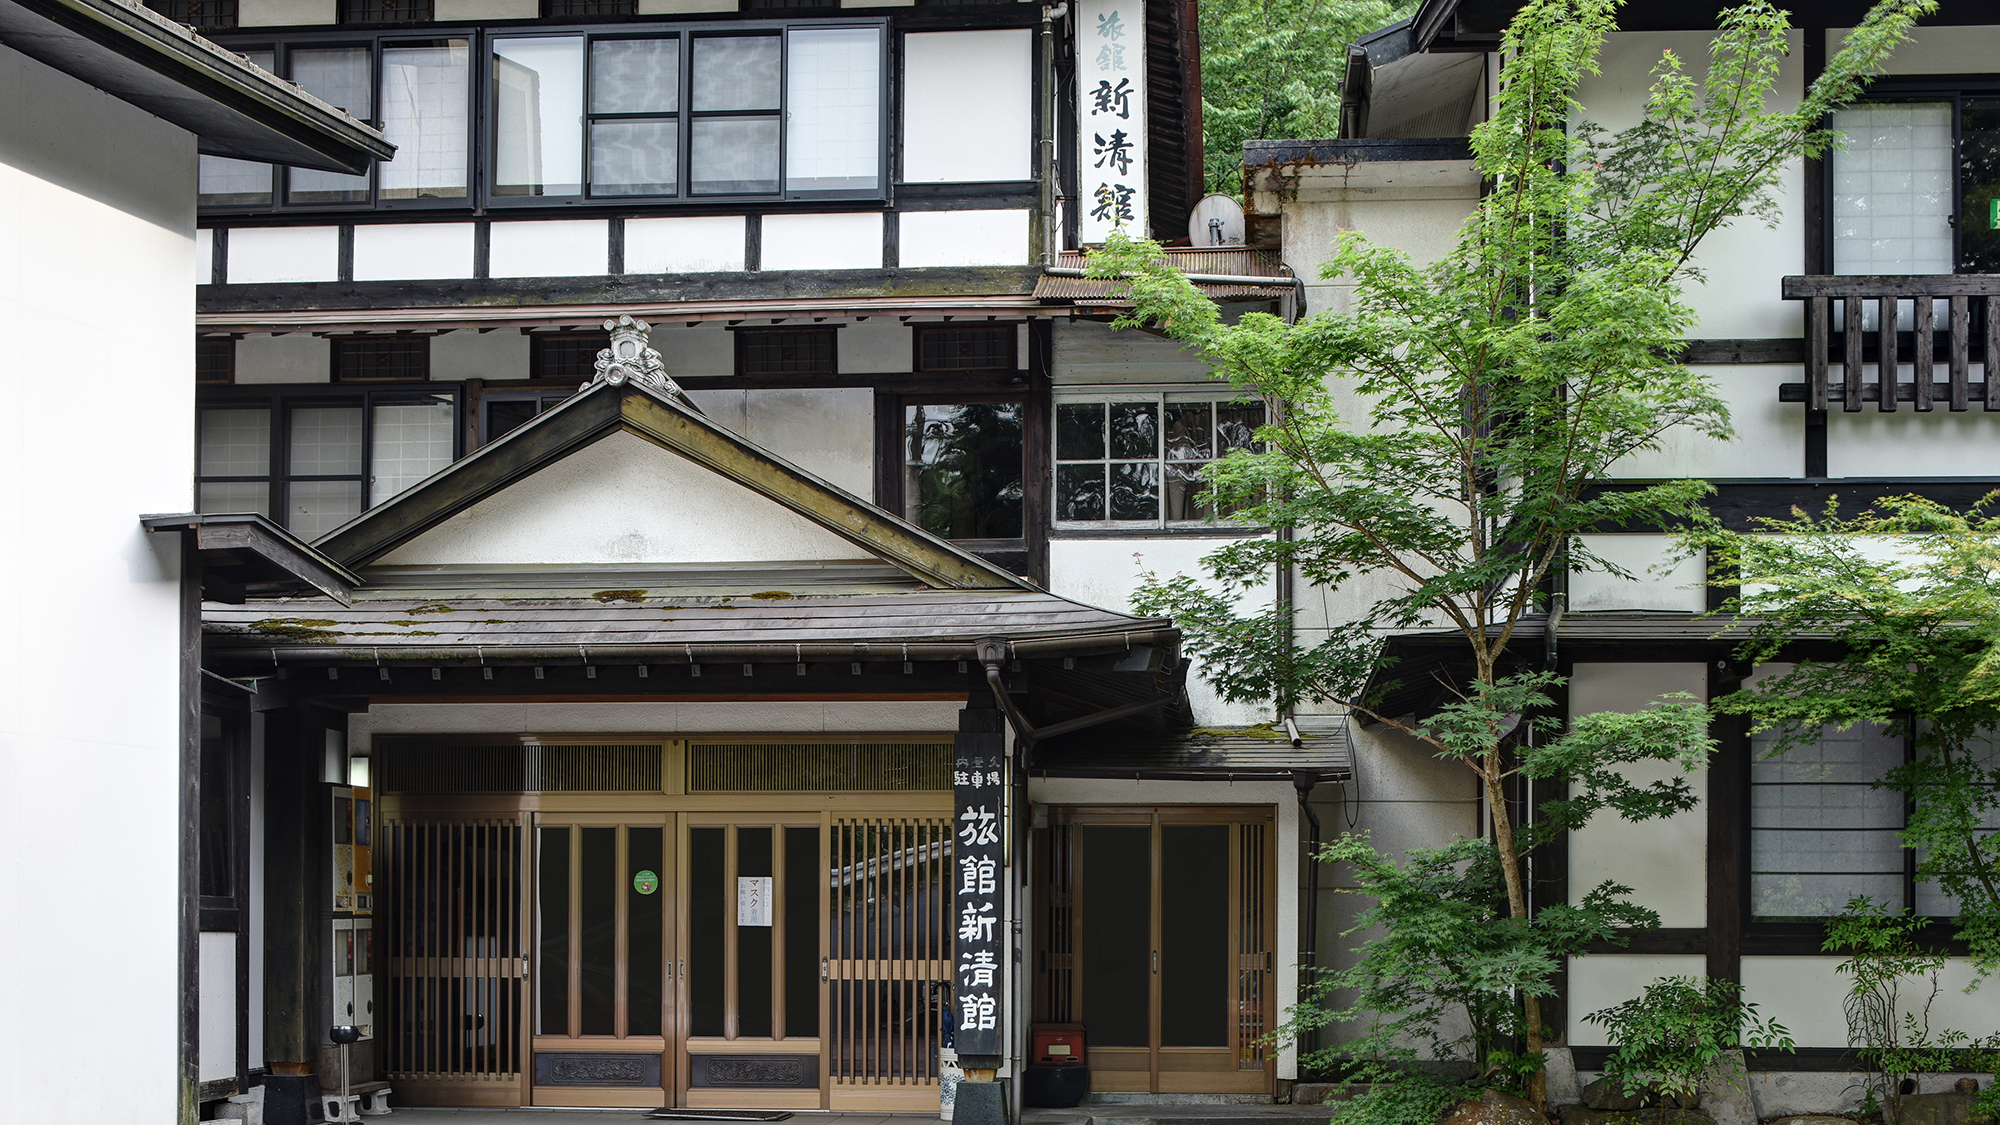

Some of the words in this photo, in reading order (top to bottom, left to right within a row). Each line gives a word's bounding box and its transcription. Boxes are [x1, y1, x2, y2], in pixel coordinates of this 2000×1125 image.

[953, 770, 1001, 789] 駐車場
[958, 804, 999, 1031] 旅館新清館
